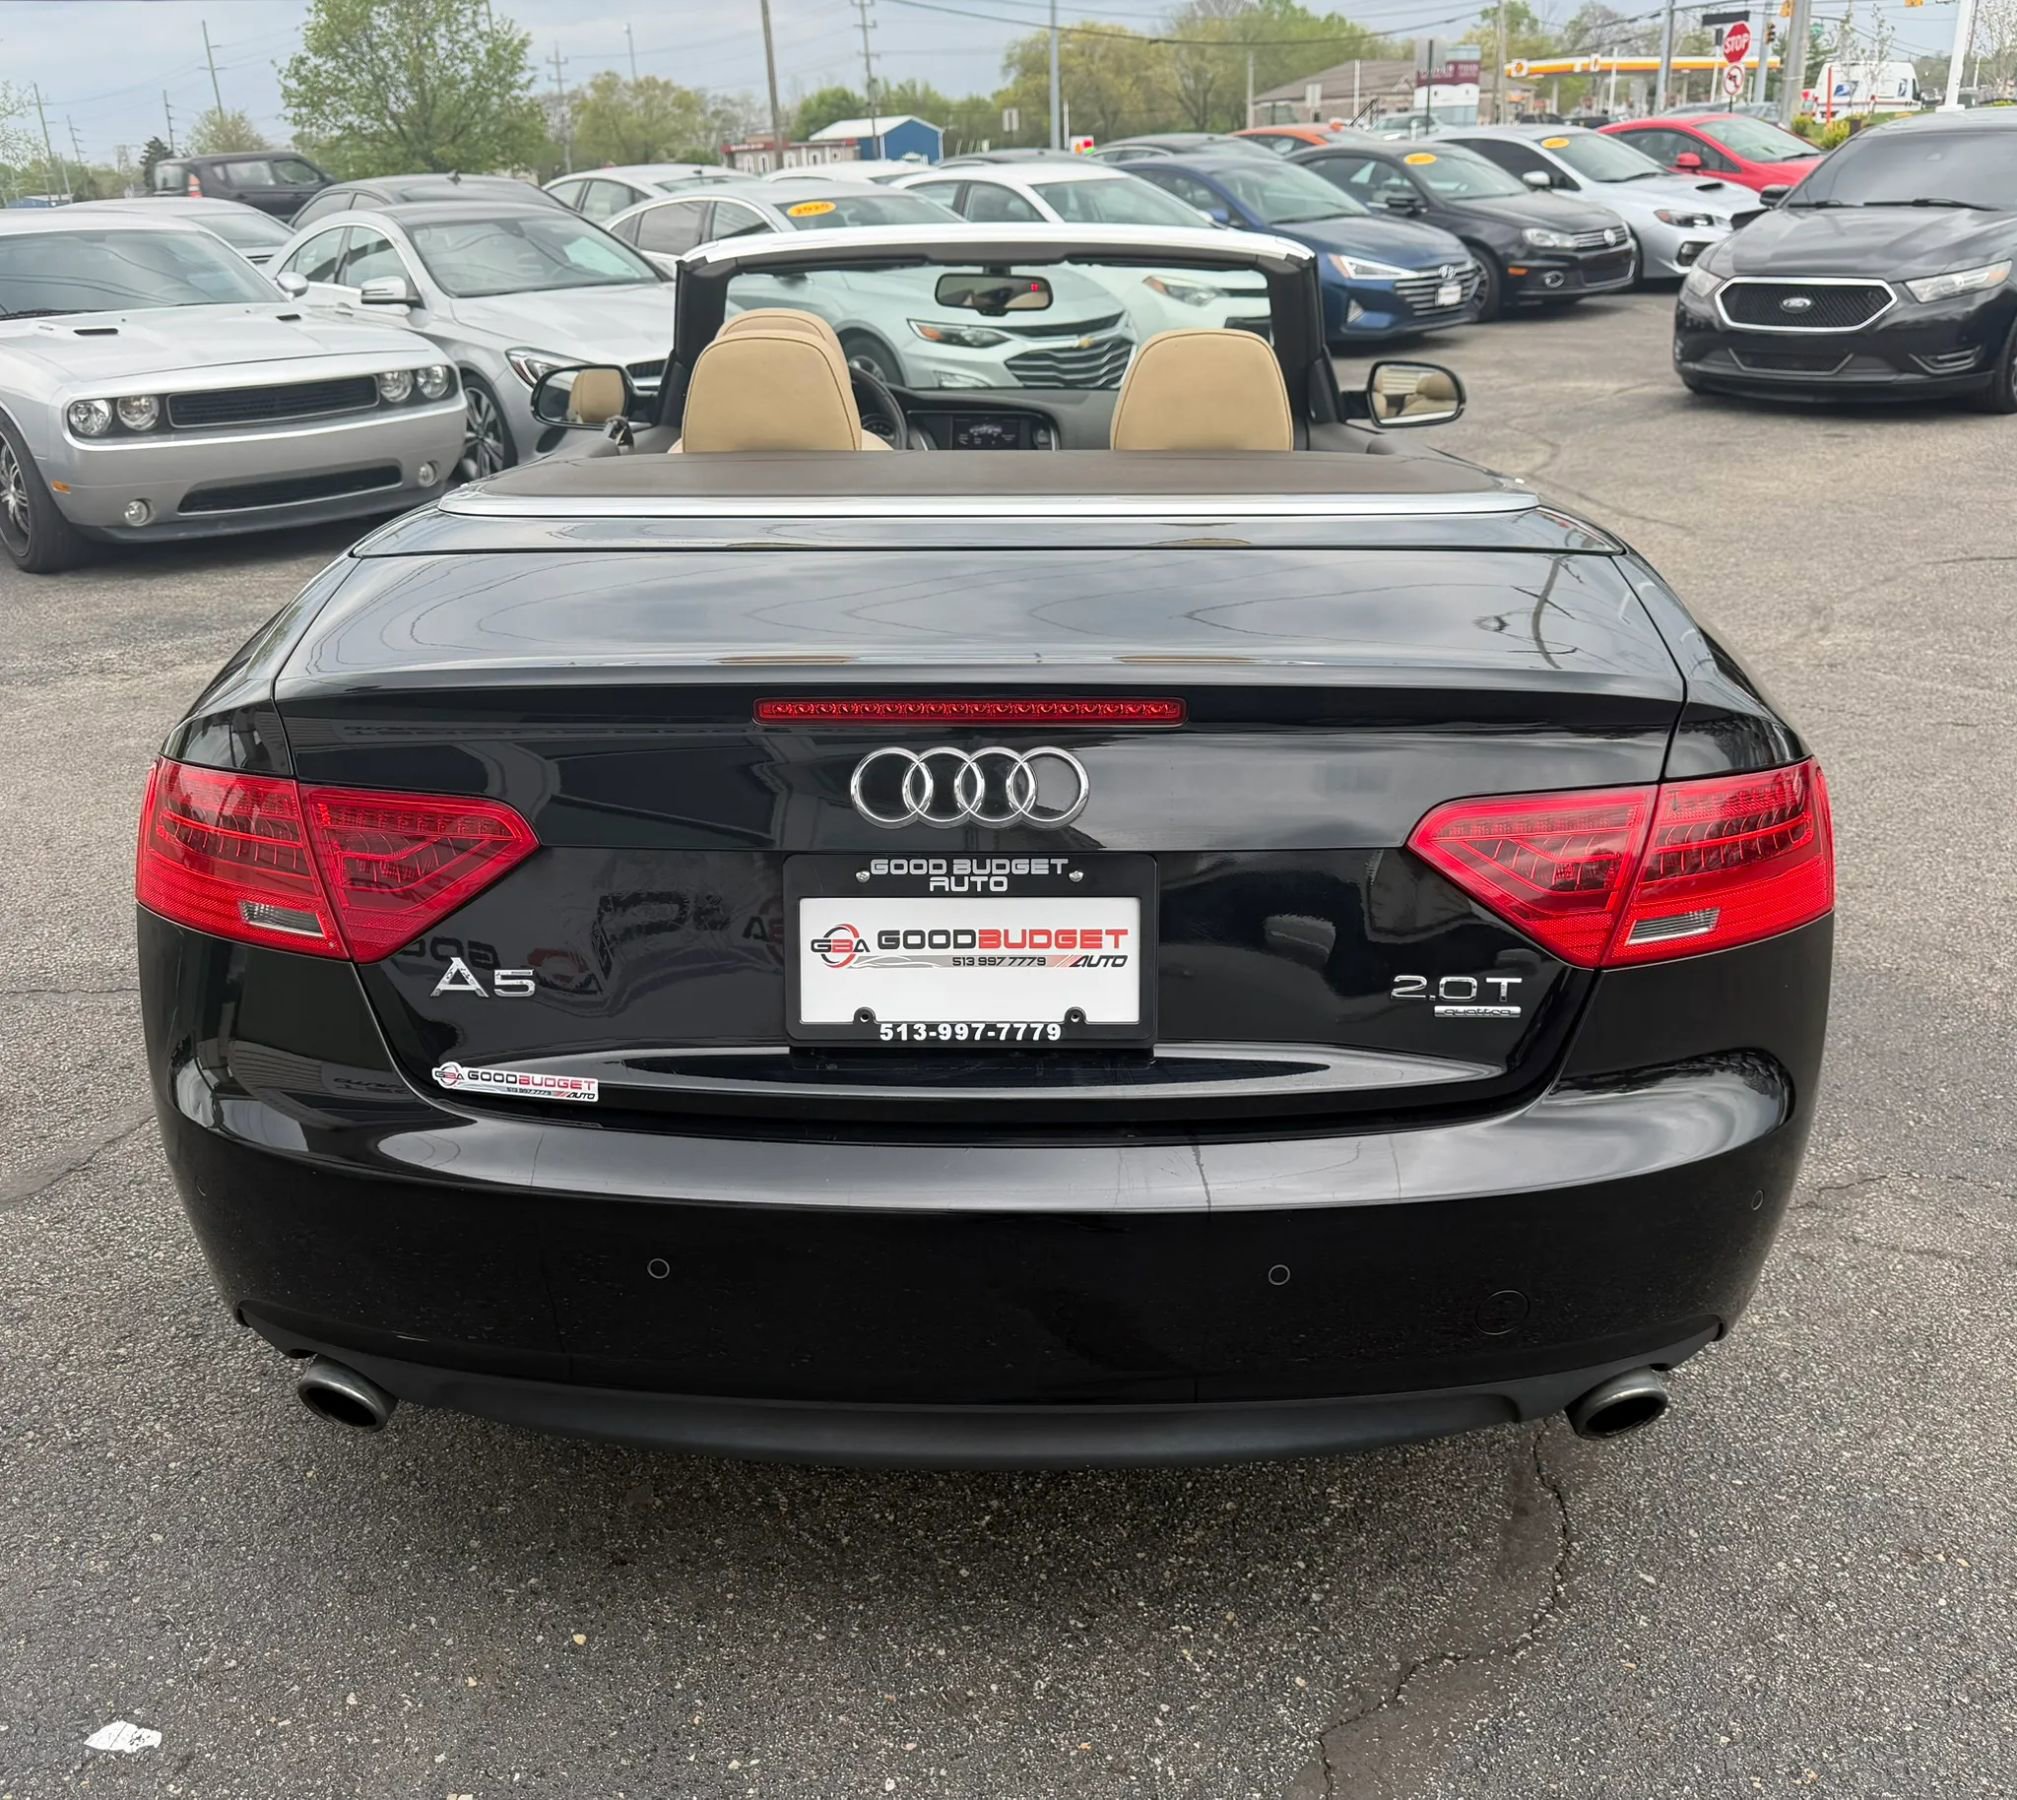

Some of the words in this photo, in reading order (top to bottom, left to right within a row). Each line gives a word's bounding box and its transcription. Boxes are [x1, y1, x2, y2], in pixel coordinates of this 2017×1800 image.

[1724, 33, 1749, 54] STOP
[870, 859, 947, 875] GOOD
[952, 858, 1069, 875] BUDGET
[929, 875, 1008, 891] AUTO
[811, 938, 870, 952] GBA
[877, 929, 1128, 949] GOODBUDGET
[952, 956, 975, 966] 513
[978, 956, 1007, 966] 997
[1007, 956, 1046, 966] 7779
[1069, 955, 1128, 967] AUTO
[430, 957, 535, 997] A5
[1391, 975, 1522, 1002] 2.0T
[1443, 1007, 1512, 1016] quattro
[879, 1023, 1061, 1041] 513-997-7779
[566, 1092, 595, 1100] AUTO
